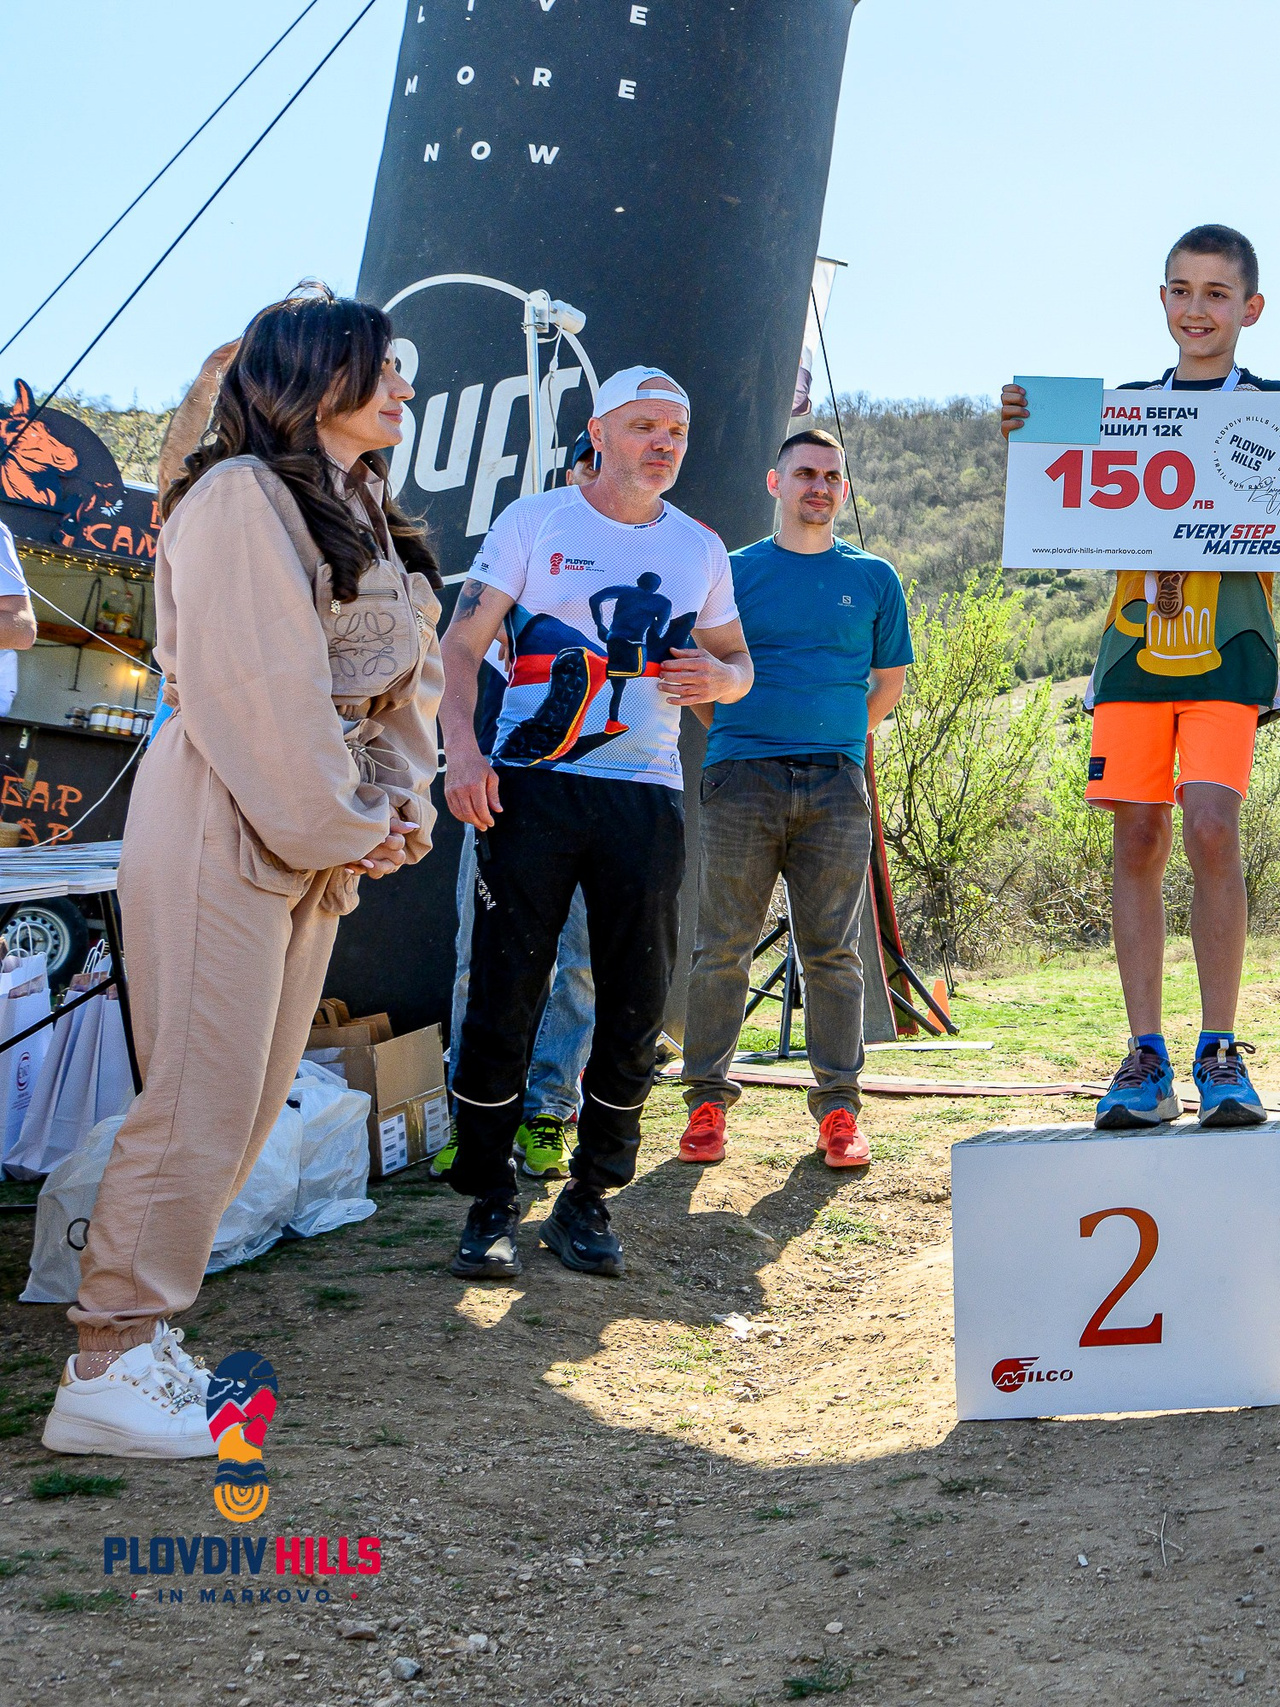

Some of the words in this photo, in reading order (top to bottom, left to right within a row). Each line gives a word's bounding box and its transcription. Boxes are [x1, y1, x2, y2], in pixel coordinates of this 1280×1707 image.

[404, 65, 637, 100] MORE
[423, 140, 560, 165] NOW
[1101, 406, 1142, 421] ЛАД
[1146, 407, 1198, 420] БЕГАЧ
[1214, 418, 1242, 445] PLOVDIV
[1245, 416, 1270, 425] HILLS
[1271, 423, 1280, 433] IN
[1229, 434, 1277, 462] PLOVDIV
[1230, 450, 1263, 472] HILLS
[1045, 450, 1196, 510] 150
[1213, 458, 1227, 481] TRAIL
[1228, 480, 1245, 490] RUN
[1173, 523, 1232, 539] EVERY
[1230, 524, 1277, 539] STEP
[1031, 546, 1153, 556] www.plovdiv-hills-in-markovo.com
[1078, 1206, 1164, 1348] 2
[995, 1369, 1073, 1386] MILCO
